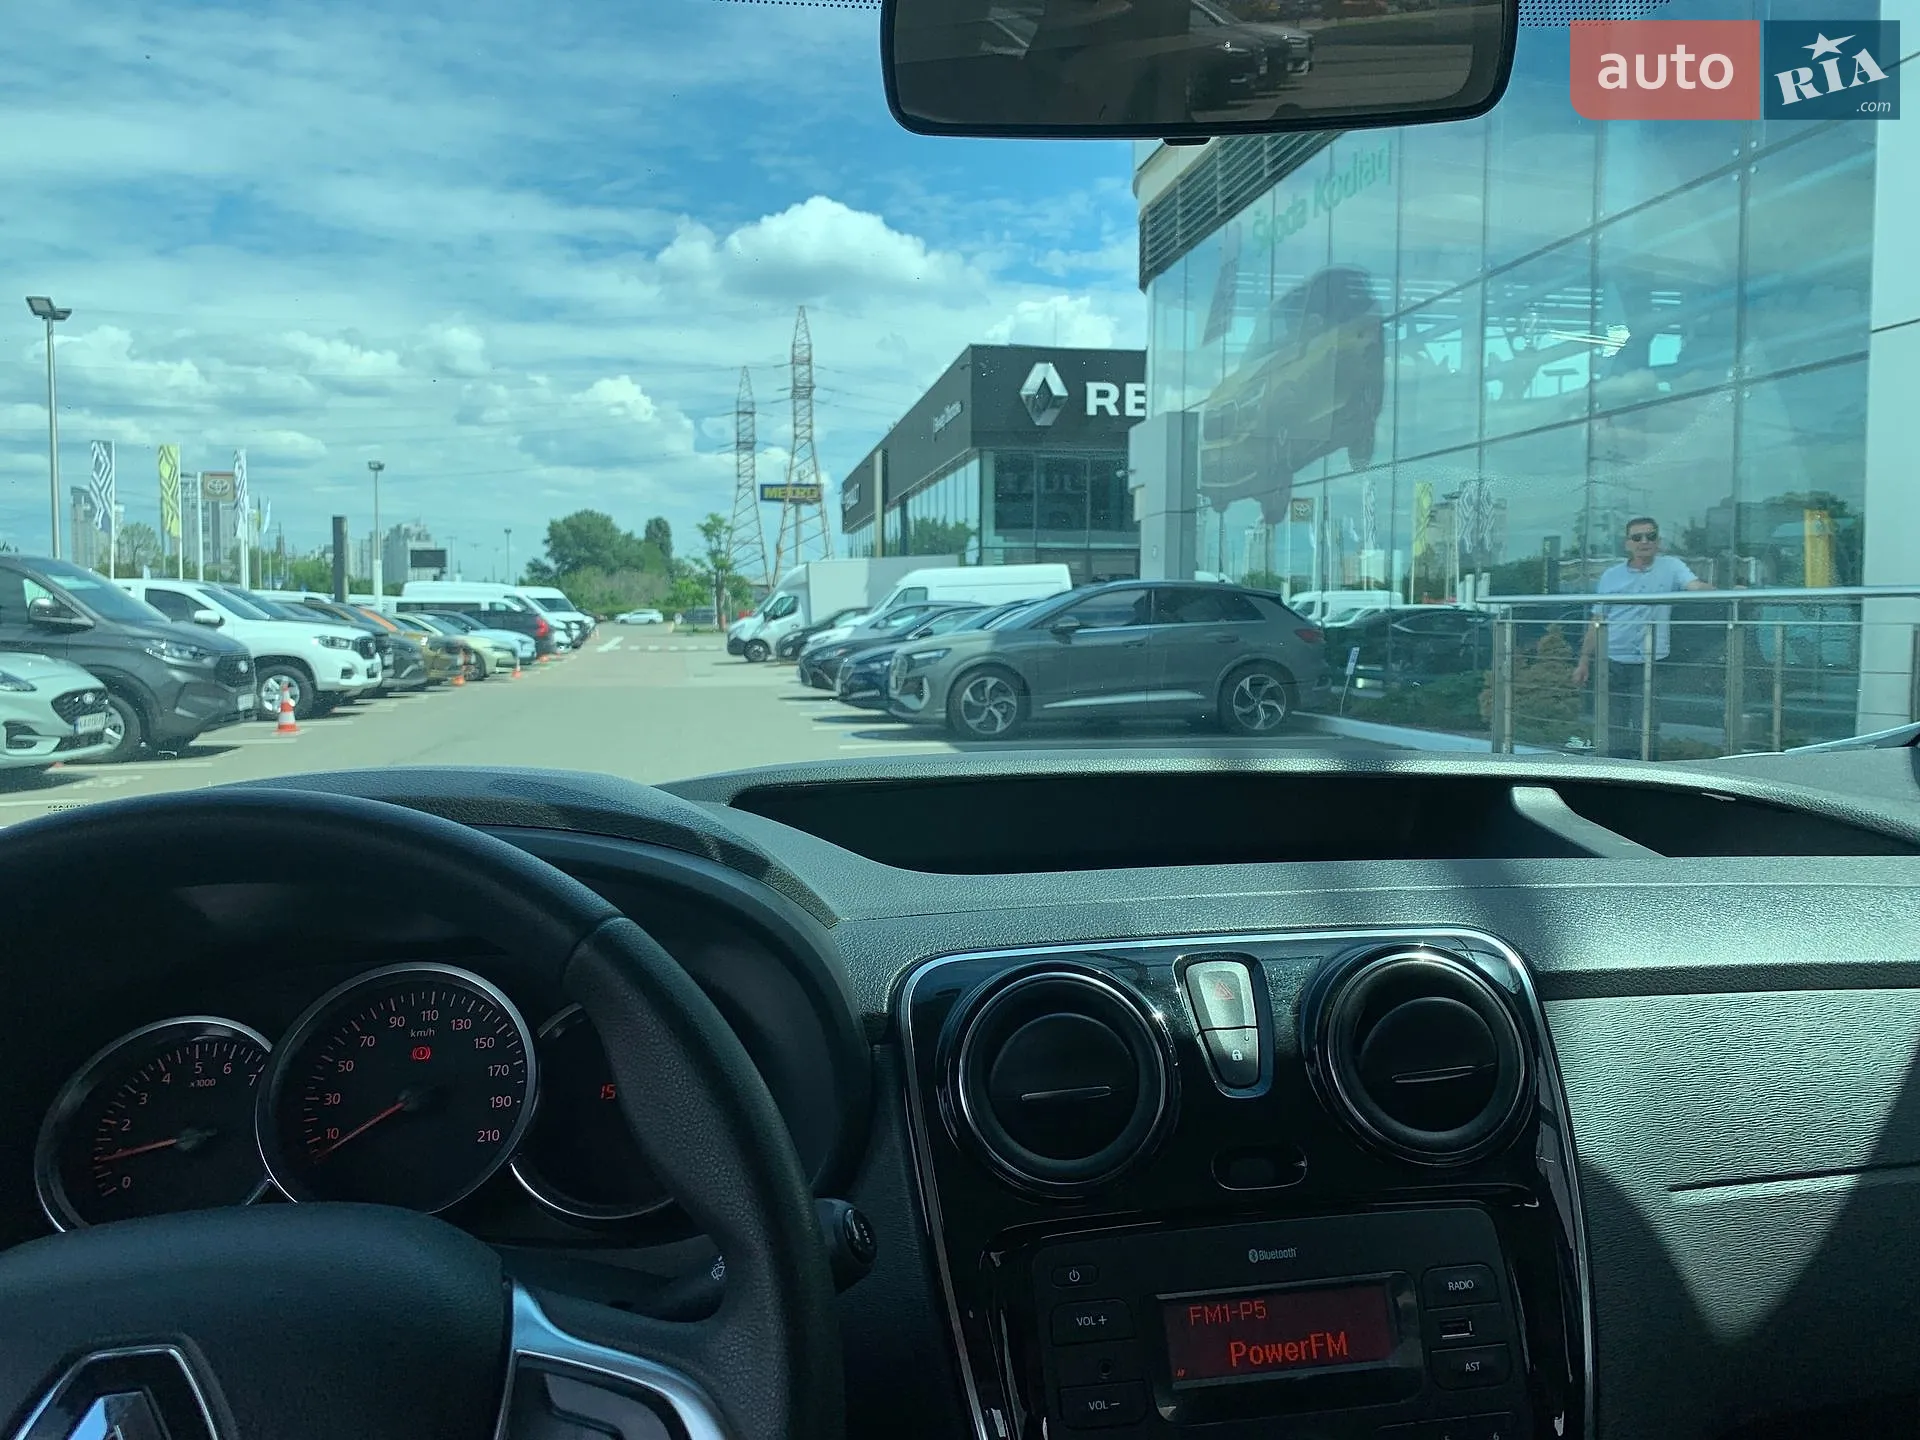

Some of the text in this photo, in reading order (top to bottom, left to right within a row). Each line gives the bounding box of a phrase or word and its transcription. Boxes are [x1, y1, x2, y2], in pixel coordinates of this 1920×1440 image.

[1085, 381, 1146, 417] RE
[389, 1016, 406, 1028] 90
[421, 1010, 439, 1022] 110
[450, 1019, 472, 1031] 130
[360, 1036, 376, 1047] 70
[474, 1037, 495, 1049] 150
[194, 1063, 203, 1074] 5
[223, 1062, 233, 1074] 6
[337, 1060, 354, 1072] 50
[487, 1065, 509, 1076] 170
[161, 1073, 171, 1085] 4
[247, 1074, 256, 1086] 7
[138, 1092, 148, 1105] 3
[323, 1093, 341, 1105] 30
[490, 1096, 512, 1108] 190
[120, 1118, 131, 1131] 2
[326, 1128, 339, 1140] 10
[477, 1130, 500, 1142] 210
[121, 1176, 131, 1189] 0
[1258, 1247, 1297, 1261] Bluetooth
[1447, 1280, 1474, 1291] RADIO
[1188, 1300, 1268, 1326] FM1-P5
[1076, 1315, 1096, 1327] VOL
[1230, 1331, 1349, 1368] PowerFM
[1465, 1361, 1481, 1372] AST
[1088, 1399, 1108, 1411] VOL
